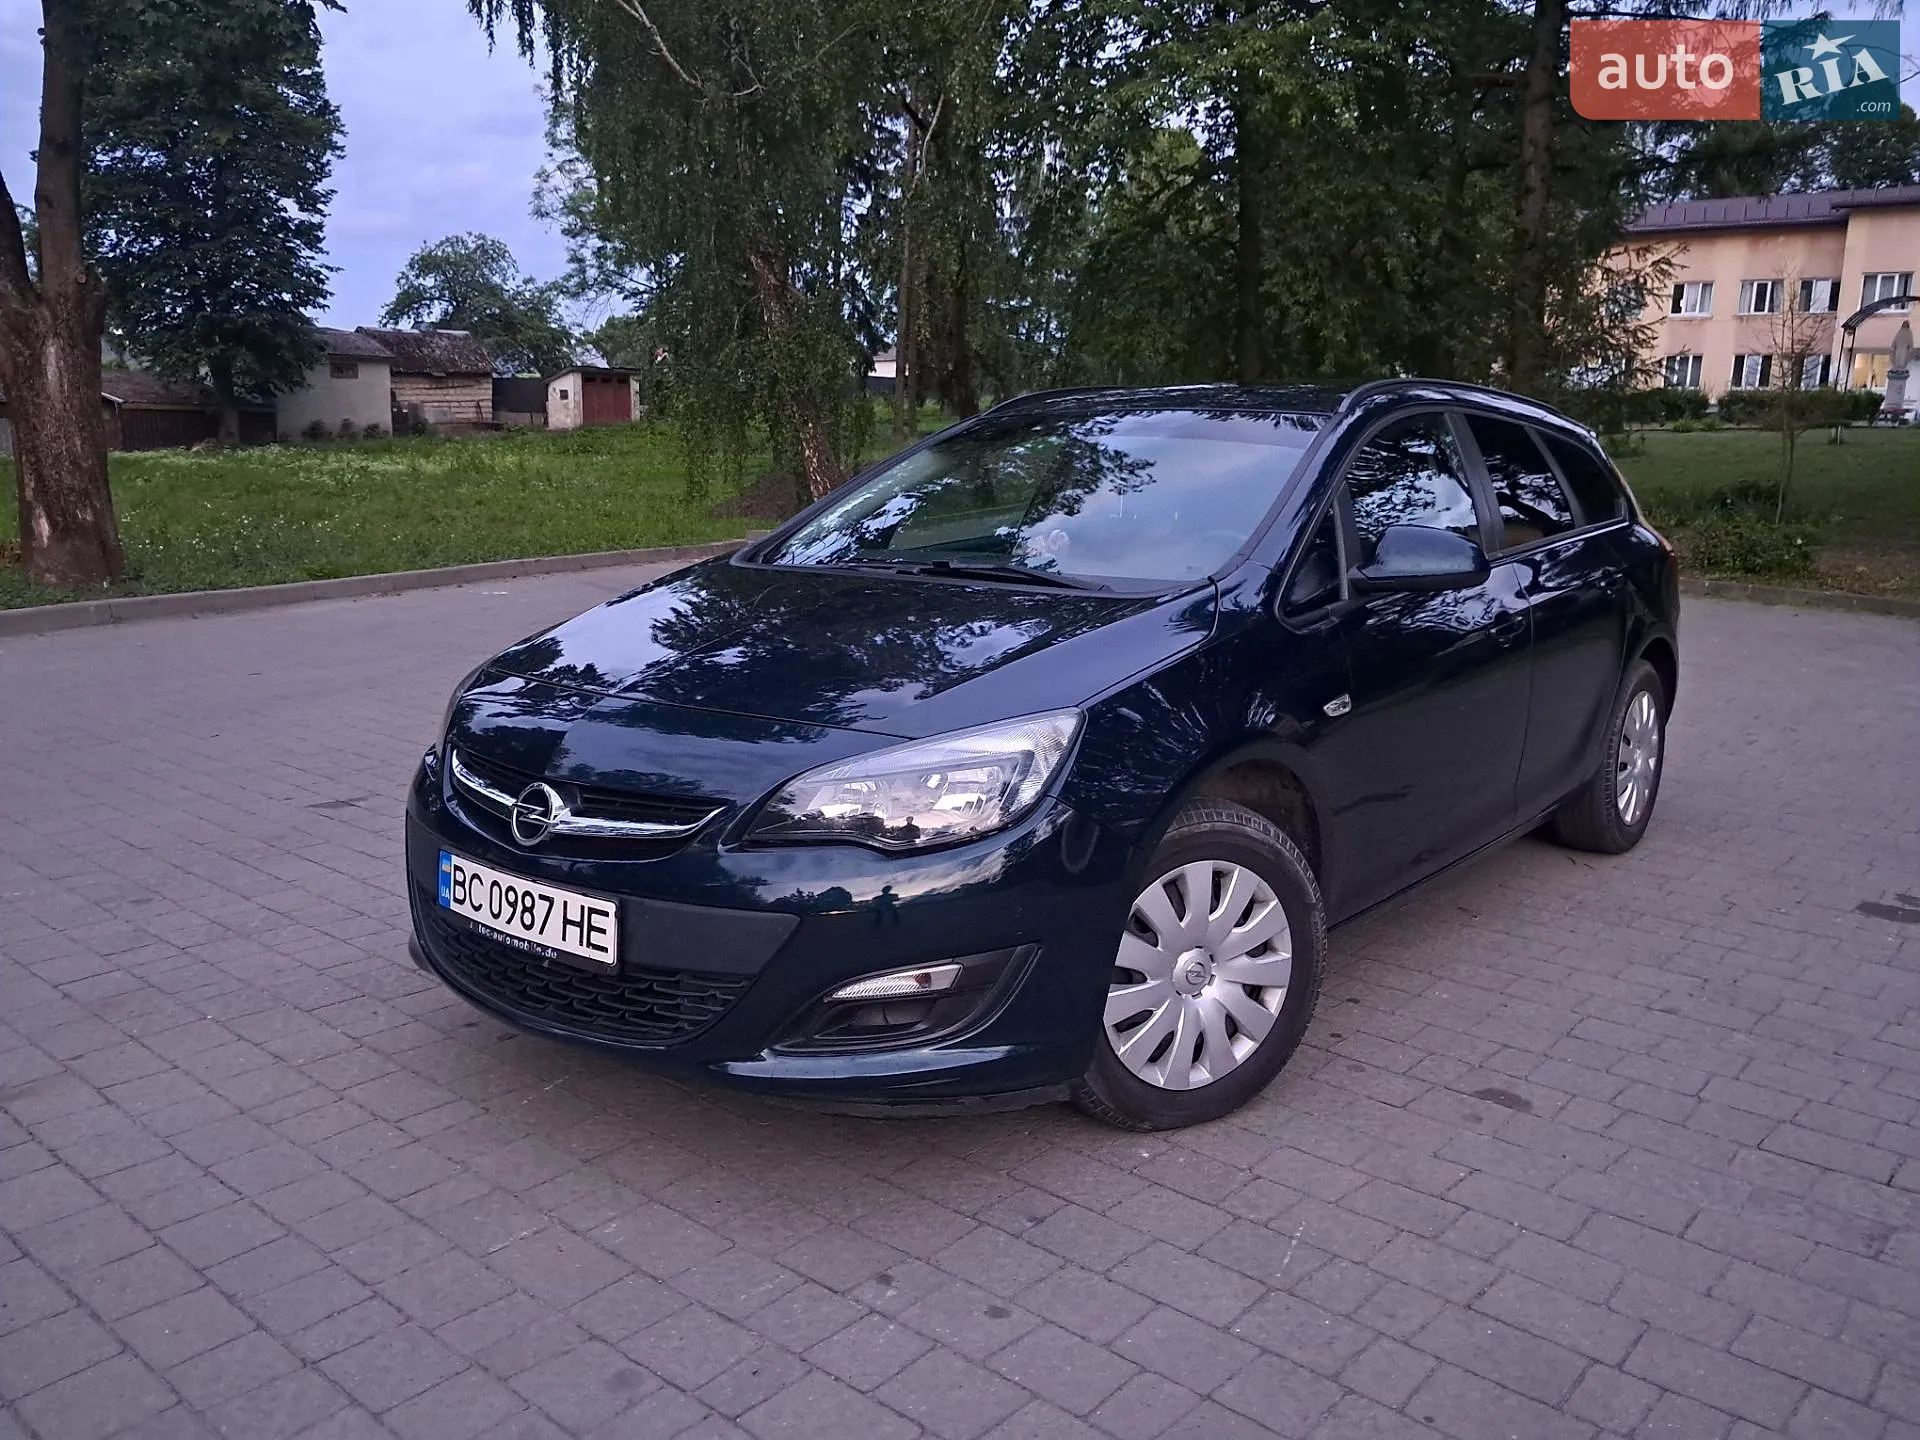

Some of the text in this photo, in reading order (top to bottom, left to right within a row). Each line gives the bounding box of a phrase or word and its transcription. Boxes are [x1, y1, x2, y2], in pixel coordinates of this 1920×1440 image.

[440, 886, 450, 899] UA
[453, 864, 610, 954] BC 0987 HE
